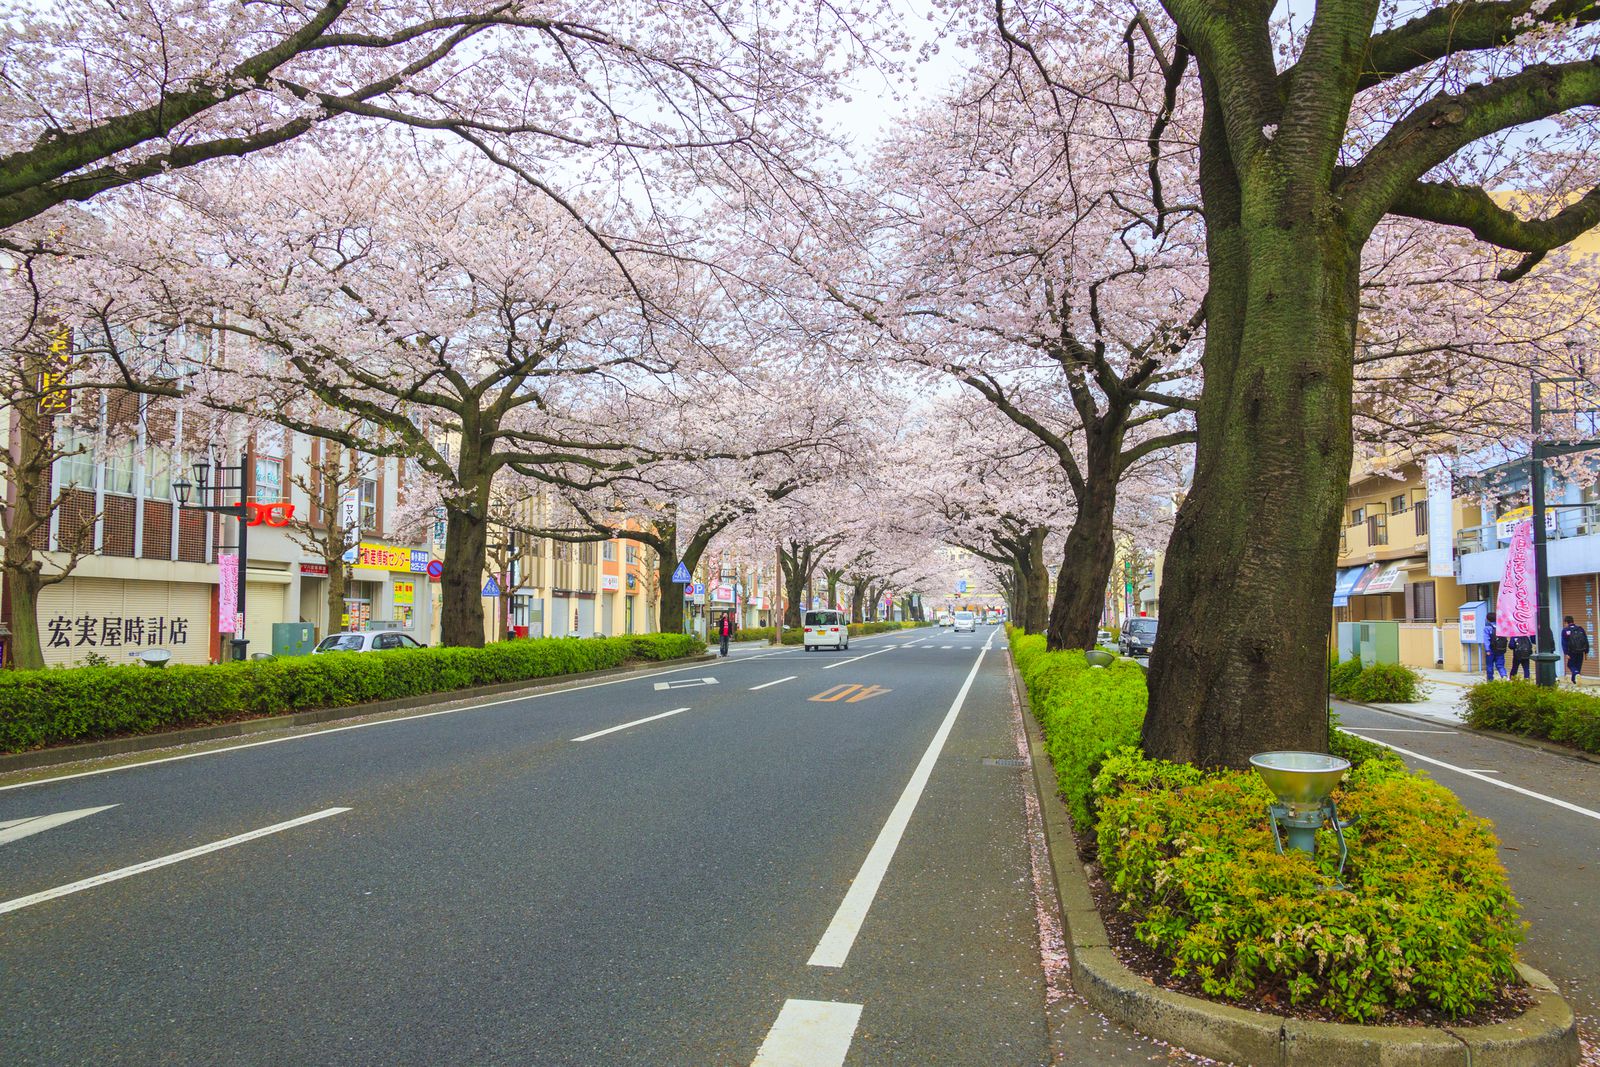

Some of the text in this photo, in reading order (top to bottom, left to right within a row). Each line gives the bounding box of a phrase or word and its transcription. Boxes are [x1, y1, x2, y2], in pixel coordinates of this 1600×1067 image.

[696, 585, 703, 594] P
[46, 615, 189, 648] 宏実屋時計店
[807, 684, 894, 703] 40
